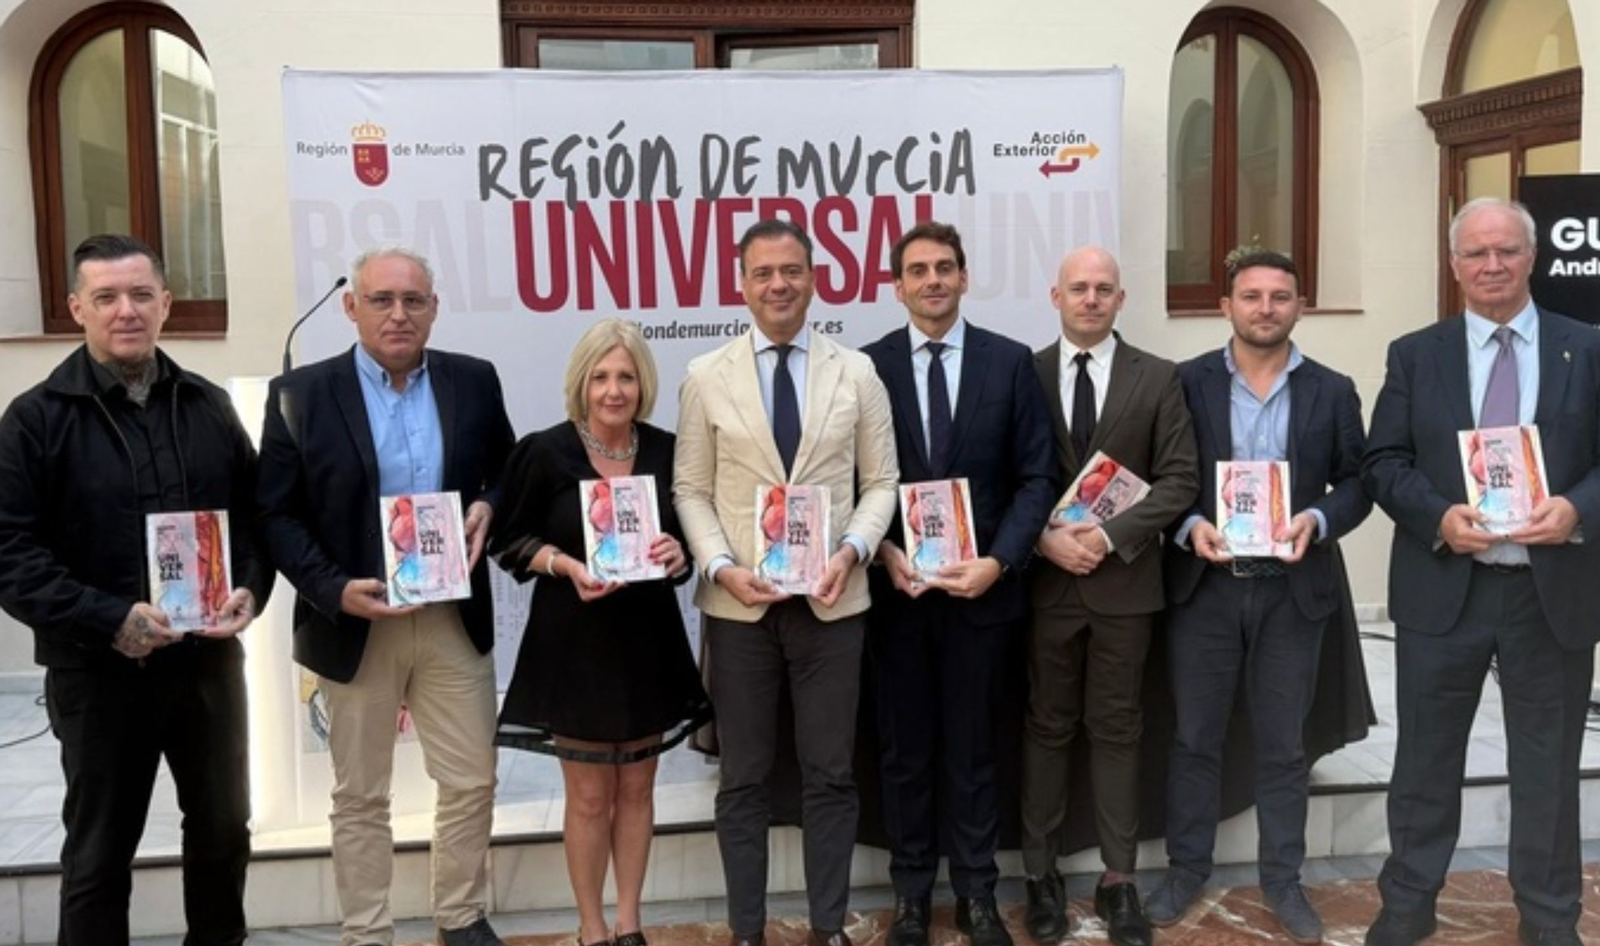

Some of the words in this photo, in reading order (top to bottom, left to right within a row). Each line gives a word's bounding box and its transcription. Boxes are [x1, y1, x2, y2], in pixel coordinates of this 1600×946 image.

[1031, 130, 1086, 144] Acción
[296, 142, 347, 158] Región
[392, 144, 411, 155] de
[415, 143, 466, 155] Murcia
[993, 144, 1058, 156] Exterior
[700, 133, 761, 200] DE
[513, 194, 933, 313] UNIVESA
[958, 190, 1115, 300] UNI
